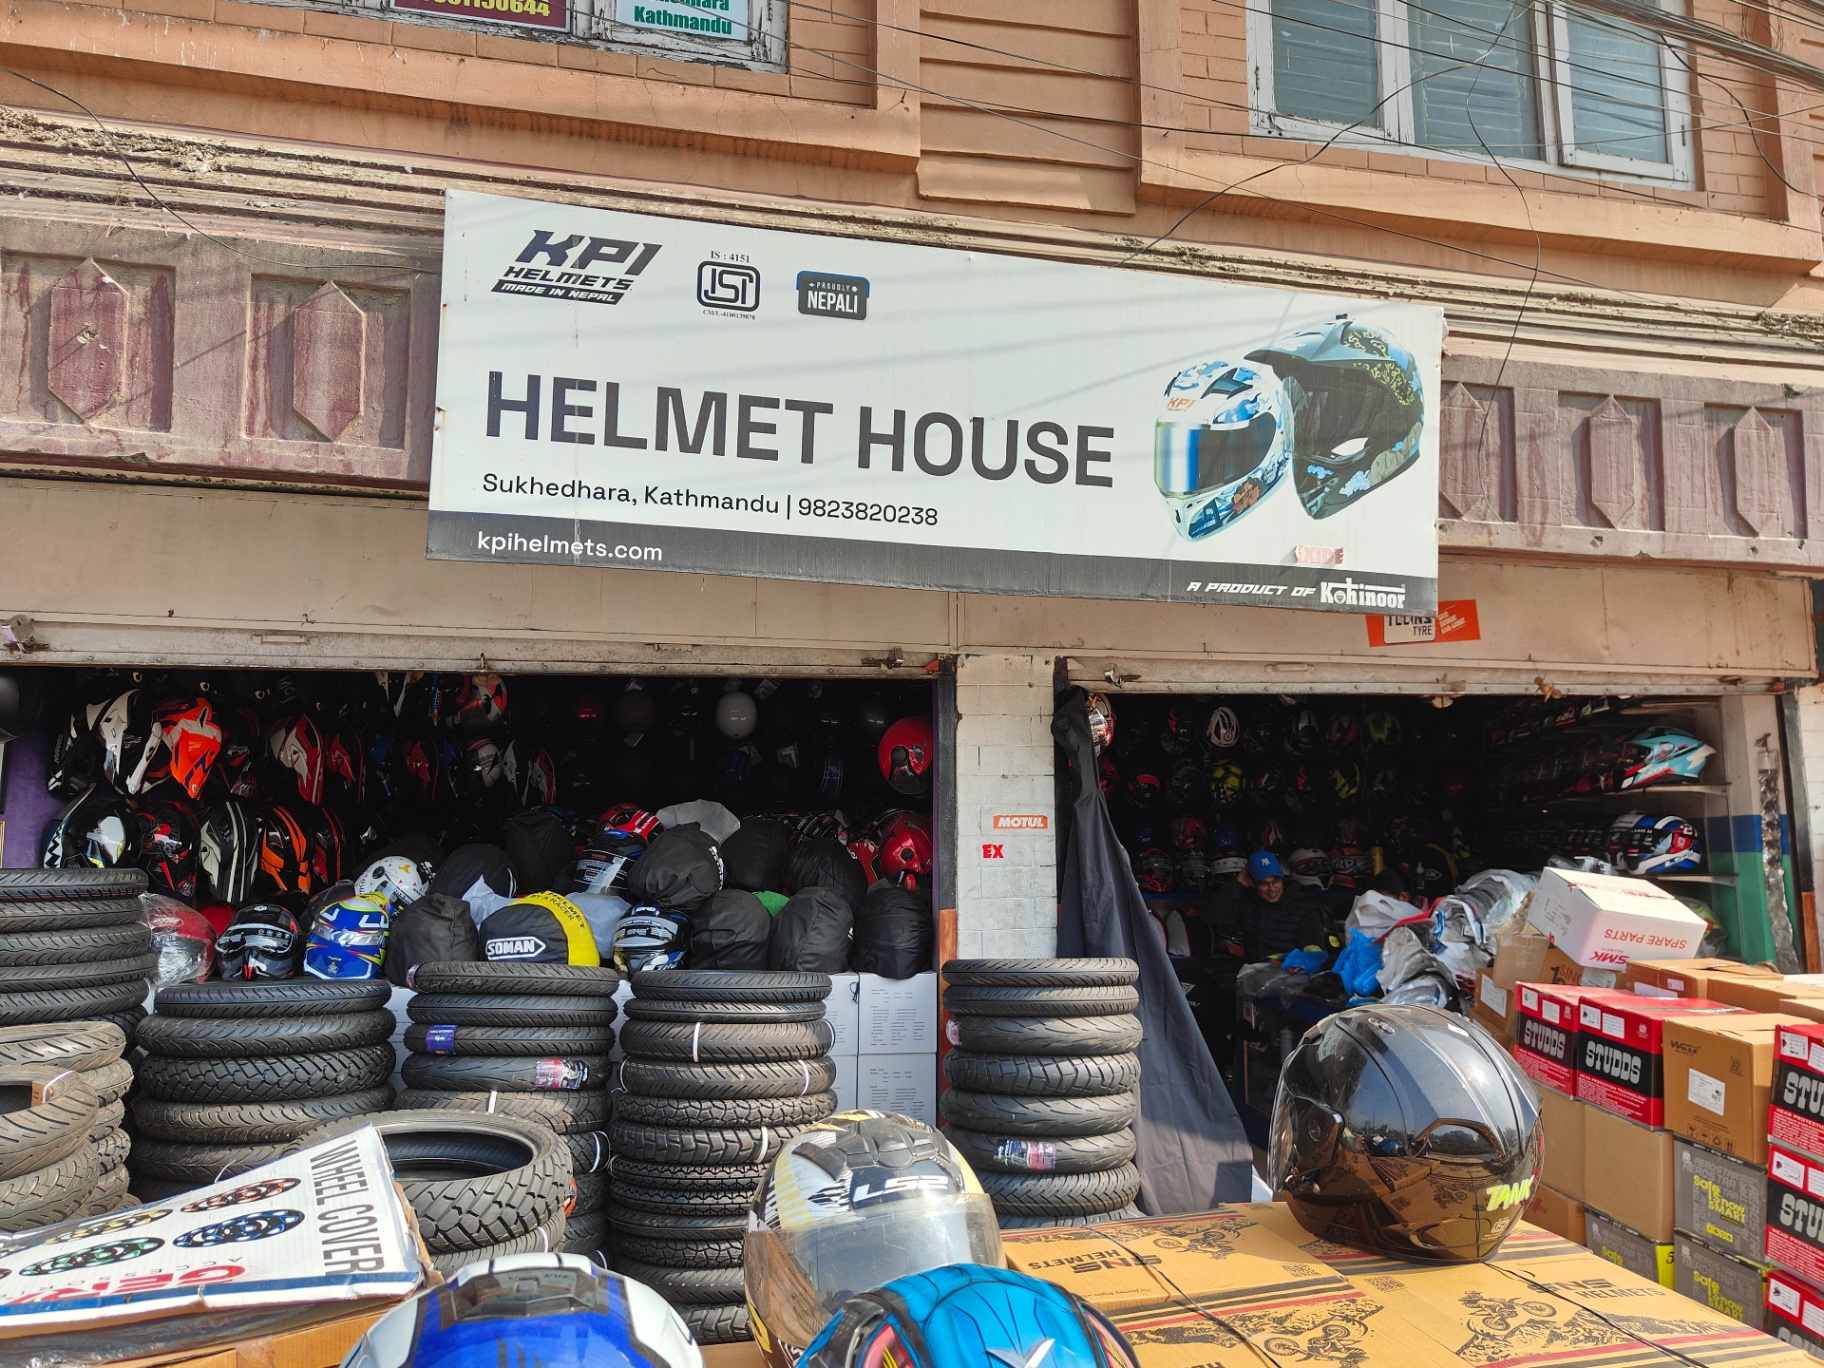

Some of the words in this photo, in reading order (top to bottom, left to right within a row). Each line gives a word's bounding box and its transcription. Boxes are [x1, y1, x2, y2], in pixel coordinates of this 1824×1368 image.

[634, 5, 732, 34] Kathmandu
[515, 229, 663, 276] KPI
[710, 250, 720, 259] IS
[729, 253, 750, 263] 4151
[503, 265, 635, 291] HELMETS
[816, 281, 851, 292] PROUDLY
[501, 282, 546, 294] MADE
[549, 288, 563, 296] IN
[568, 290, 616, 302] NEPAL
[807, 290, 858, 314] NEPALI
[485, 370, 834, 465] HELMET
[857, 405, 1115, 488] HOUSE
[482, 472, 638, 506] Sukhedhara,
[644, 485, 779, 514] Kathmandu
[798, 497, 939, 526] 9823820238
[477, 530, 662, 562] kpihelmets.com
[1186, 581, 1202, 592] A
[1205, 582, 1288, 597] PRODUCT
[1290, 586, 1318, 597] OF
[1320, 577, 1406, 609] Kohinoor
[1413, 625, 1432, 636] TYRE
[998, 817, 1044, 828] MOTUL
[982, 844, 1005, 859] EX
[486, 940, 536, 956] SOMAN
[1604, 928, 1645, 944] PARTS
[1646, 935, 1688, 950] SPARE
[1588, 950, 1631, 965] SMK
[1523, 1019, 1566, 1060] STUDDS
[1585, 1039, 1642, 1085] STUDDS
[1783, 1071, 1824, 1117] STU
[1776, 1107, 1793, 1118] HEAD
[309, 1139, 371, 1206] WHEEL
[853, 1174, 949, 1203] LS2
[1486, 1174, 1535, 1212] TANK
[1708, 1200, 1746, 1224] SMART
[1779, 1192, 1824, 1248] STU
[316, 1203, 386, 1275] COVER
[1771, 1227, 1789, 1241] HEAD
[1028, 1249, 1121, 1270] HELMETS
[1574, 1287, 1667, 1300] HELMETS
